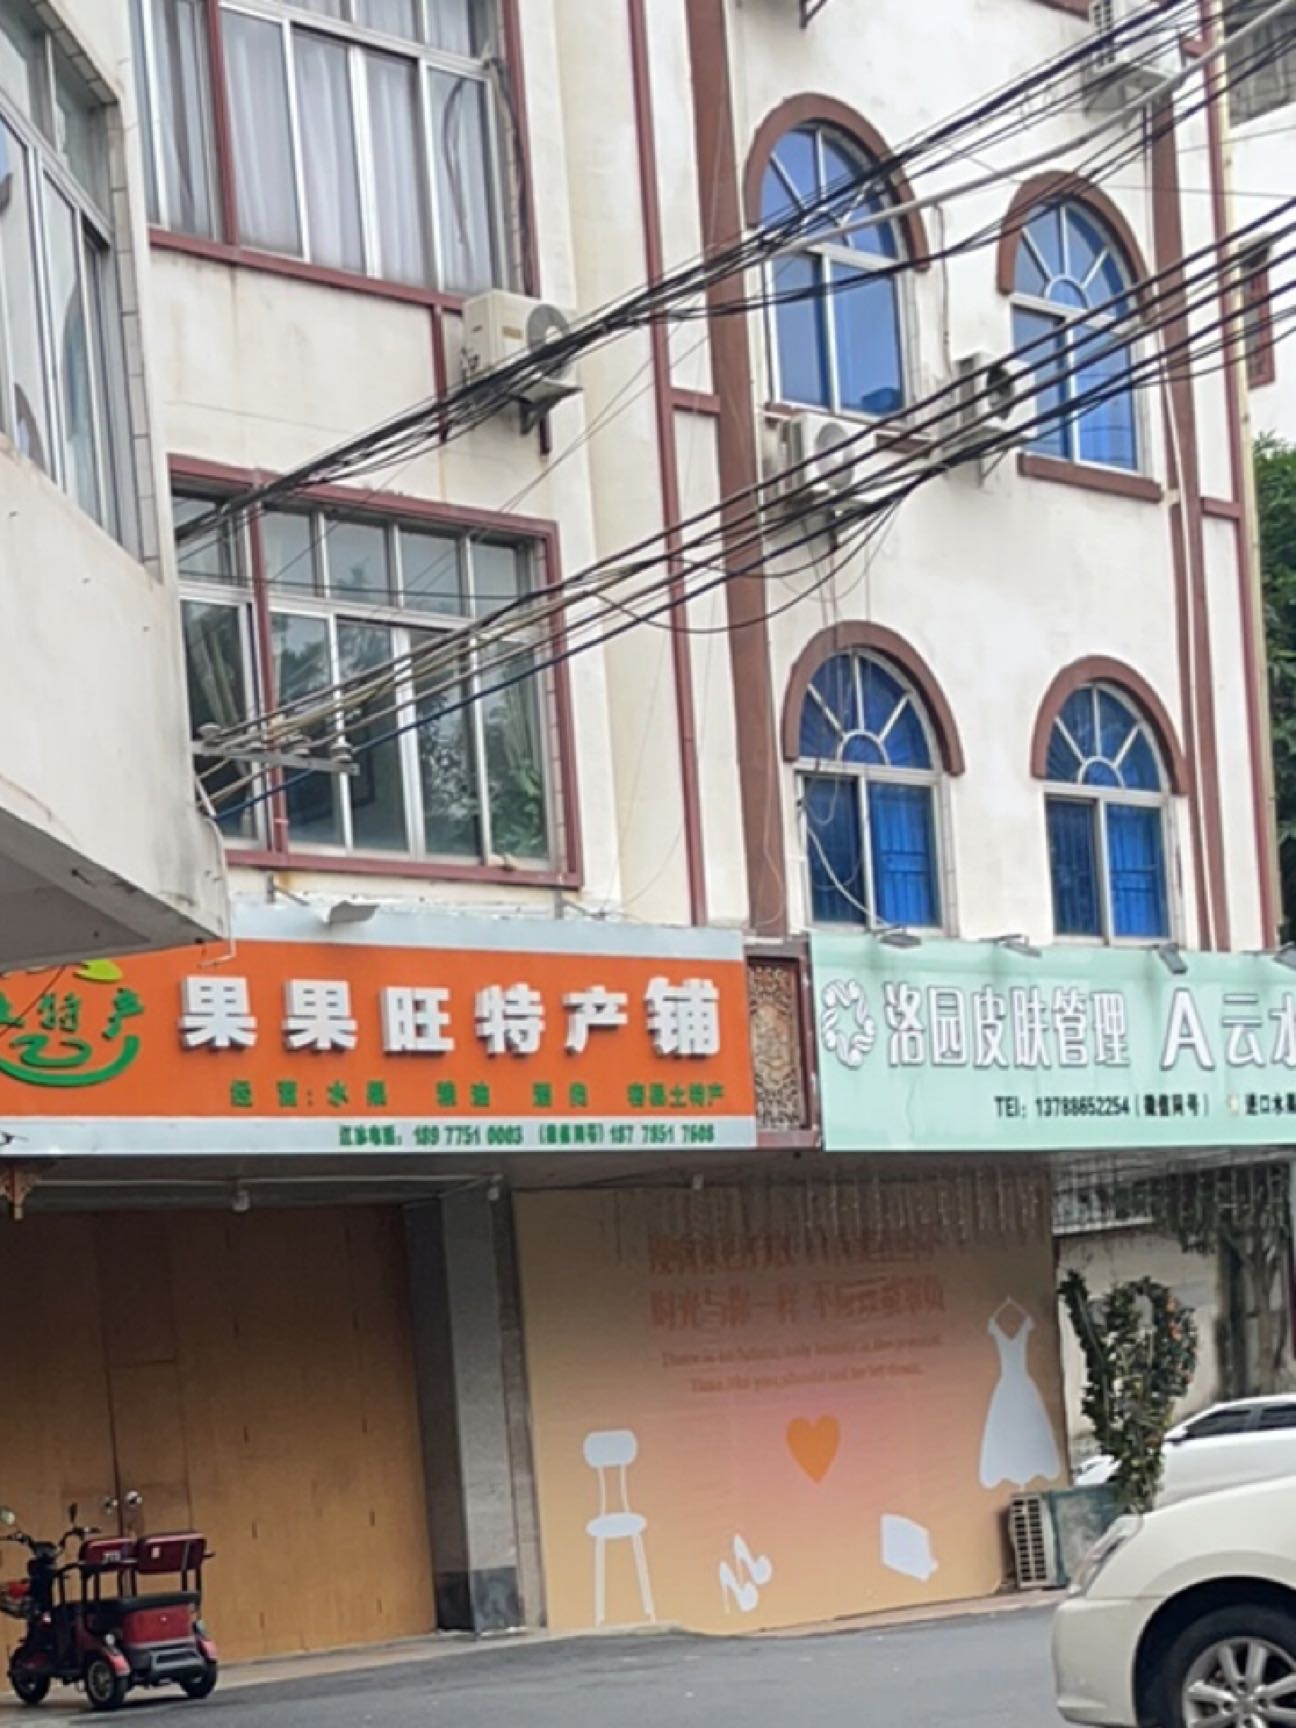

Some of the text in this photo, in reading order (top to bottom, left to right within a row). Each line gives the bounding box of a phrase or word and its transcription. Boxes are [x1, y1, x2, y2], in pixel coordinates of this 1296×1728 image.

[178, 975, 720, 1056] 果果旺特产铺
